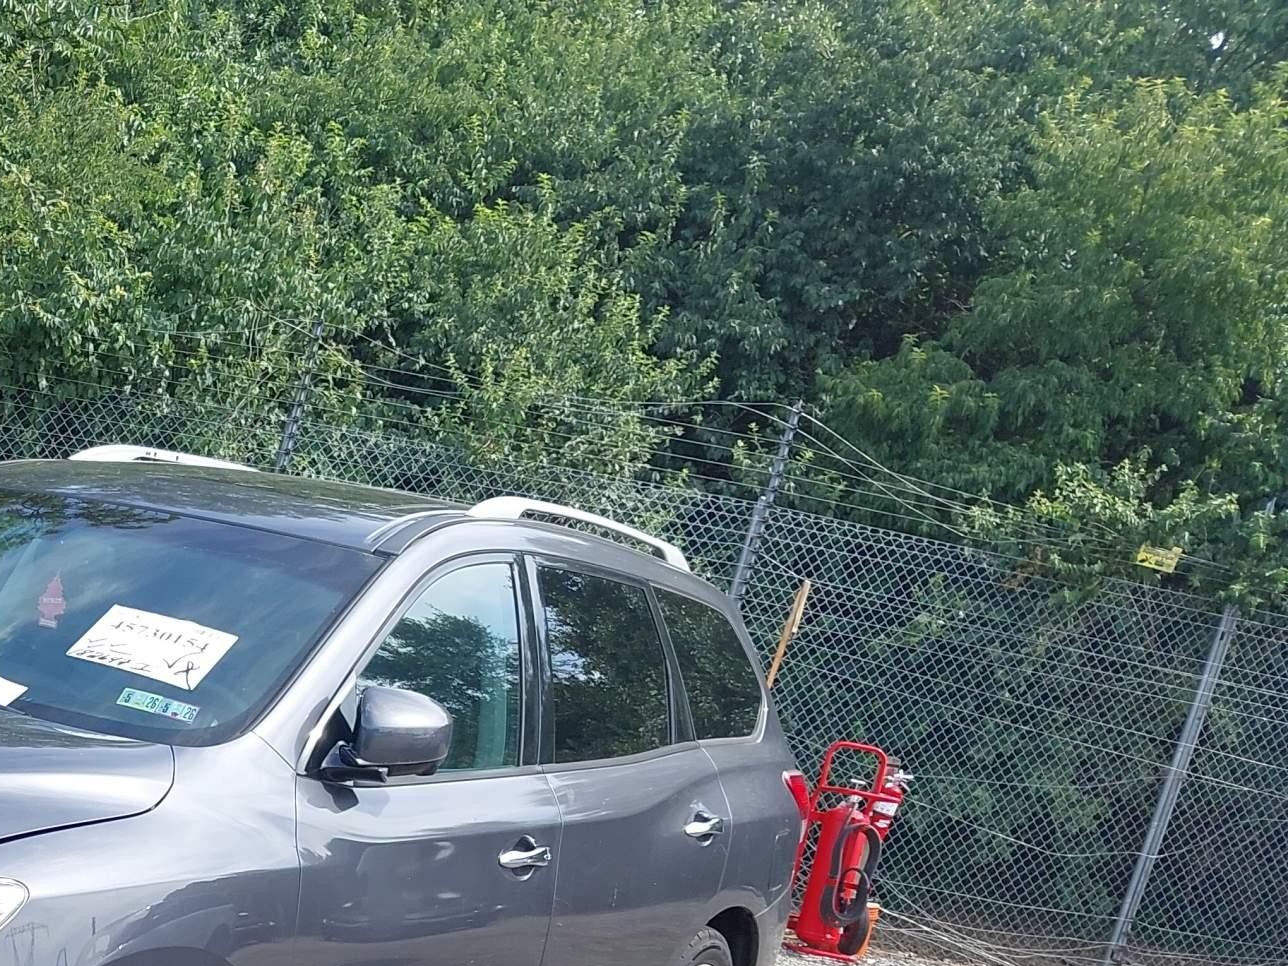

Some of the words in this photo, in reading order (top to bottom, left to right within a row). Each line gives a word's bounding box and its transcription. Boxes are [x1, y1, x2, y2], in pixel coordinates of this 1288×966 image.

[112, 620, 209, 653] 45730154
[145, 696, 160, 709] 26
[183, 706, 198, 720] 26
